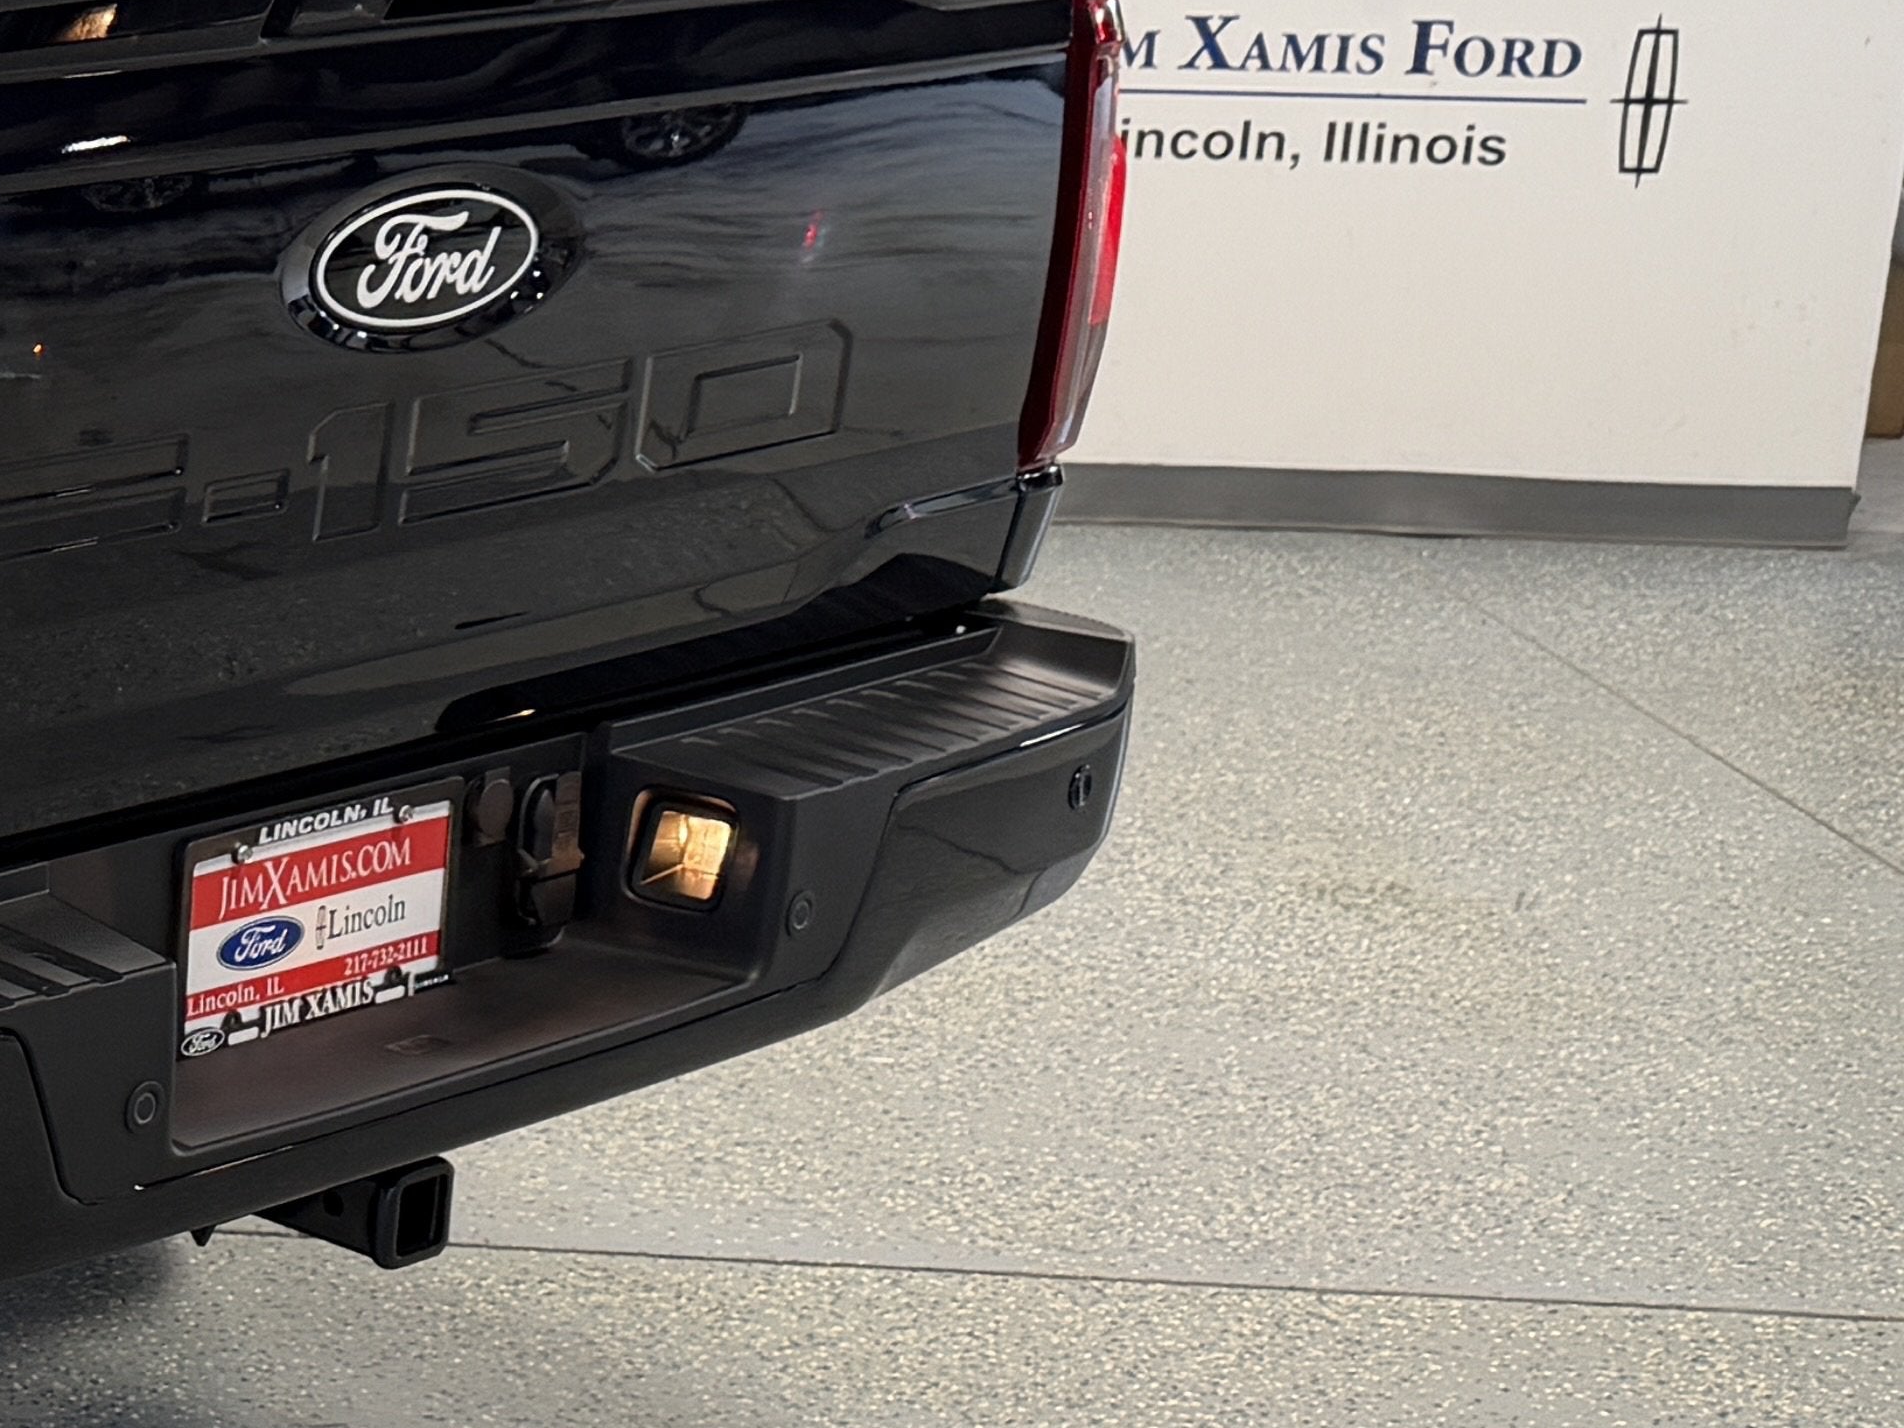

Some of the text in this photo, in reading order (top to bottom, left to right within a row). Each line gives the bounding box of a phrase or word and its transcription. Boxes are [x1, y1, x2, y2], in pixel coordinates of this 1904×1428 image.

[1177, 14, 1385, 73] XAMIS
[1403, 18, 1582, 78] FORD
[1121, 117, 1506, 170] incoln, Illinois
[357, 211, 502, 309] Ford
[258, 797, 394, 844] LINCOLN, IL
[218, 837, 411, 919] JIMXAMIS.COM
[328, 895, 405, 940] Lincoln
[234, 926, 286, 961] Ford
[344, 938, 428, 976] 217-732-2111
[260, 1001, 300, 1036] JIM
[305, 979, 375, 1018] XAMIS
[267, 978, 285, 997] IL
